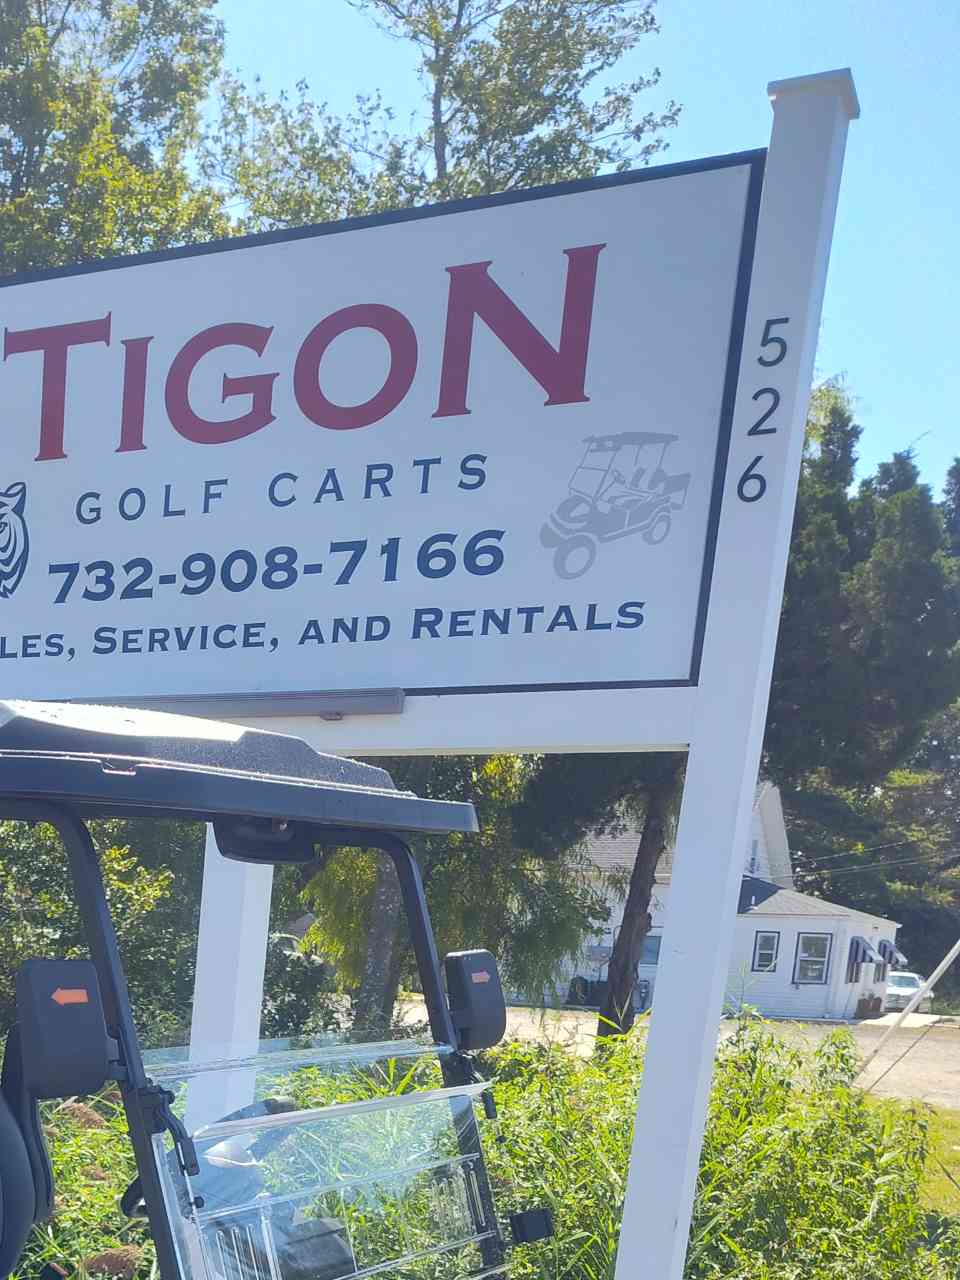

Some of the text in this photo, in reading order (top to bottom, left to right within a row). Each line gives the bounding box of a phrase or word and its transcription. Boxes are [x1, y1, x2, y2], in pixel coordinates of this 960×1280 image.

[3, 242, 608, 462] TIGON
[75, 453, 489, 525] GOLF CARTS
[47, 529, 507, 604] 732-908-7166
[92, 620, 281, 655] SERVICE,
[298, 614, 392, 647] AND
[410, 600, 646, 640] RENTALS
